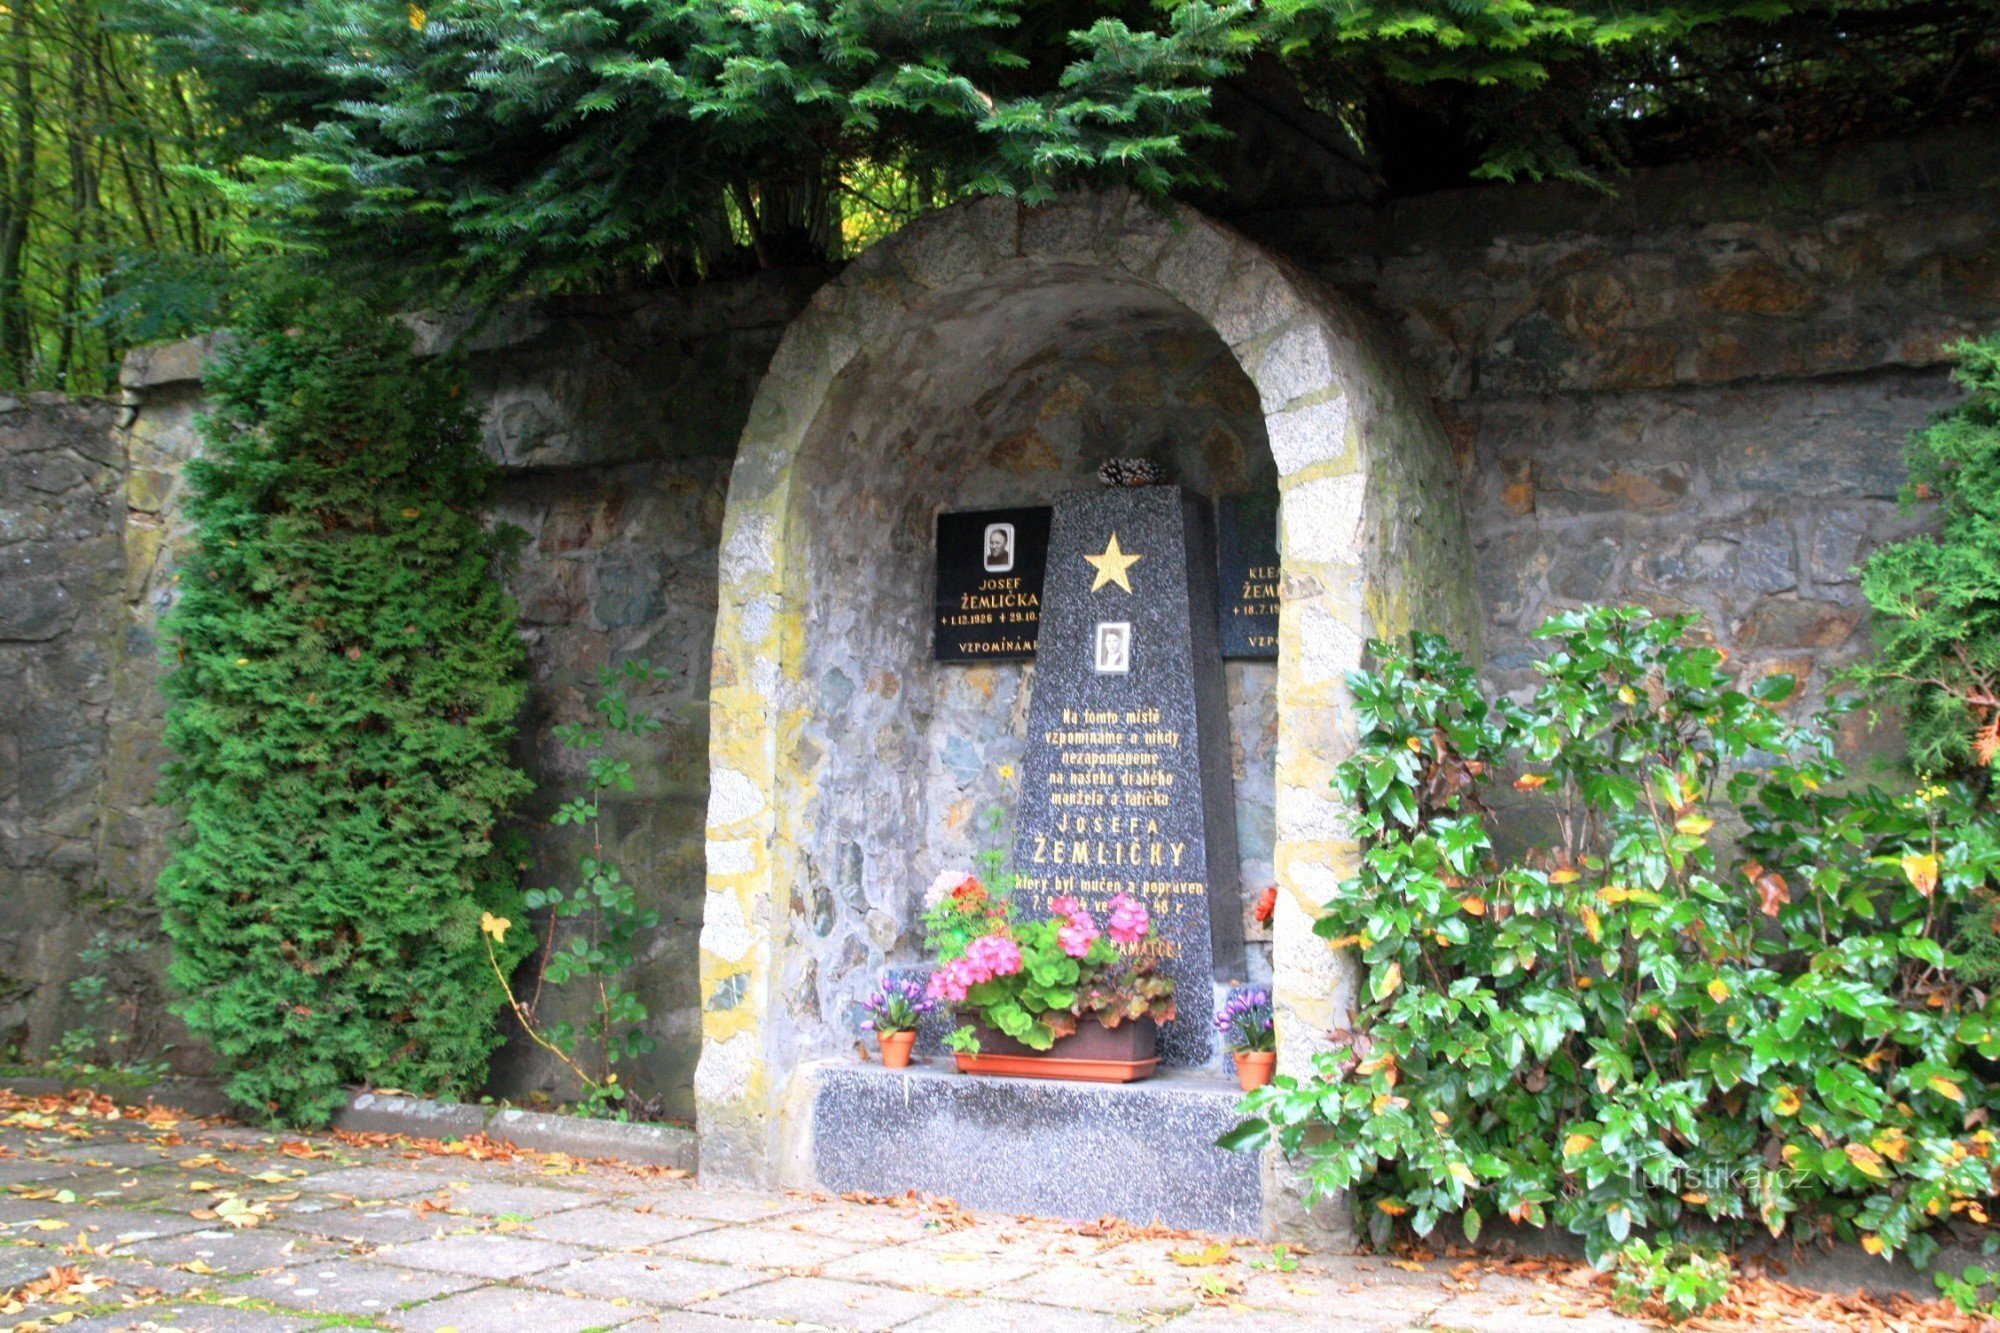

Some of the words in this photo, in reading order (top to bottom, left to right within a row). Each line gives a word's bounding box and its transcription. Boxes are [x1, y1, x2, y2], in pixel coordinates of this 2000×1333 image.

[979, 578, 1022, 591] JOSEF
[961, 590, 1039, 610] ŽEMLIČKA
[1010, 611, 1041, 623] 29.10.
[1063, 708, 1078, 725] Na
[1084, 708, 1119, 725] tomto
[1130, 733, 1139, 745] a
[1145, 729, 1181, 749] nikdy
[1062, 752, 1159, 767] nezapomeneme
[1050, 772, 1064, 786] na
[1070, 770, 1115, 787] našeho
[1051, 789, 1104, 806] manžela
[1110, 795, 1118, 806] a
[1058, 813, 1160, 835] JOSEFA
[1033, 831, 1186, 867] ŽEMLIČKY
[1055, 875, 1074, 894] byl
[1081, 876, 1122, 893] mučen
[1128, 881, 1137, 893] a
[1143, 879, 1204, 898] popraven
